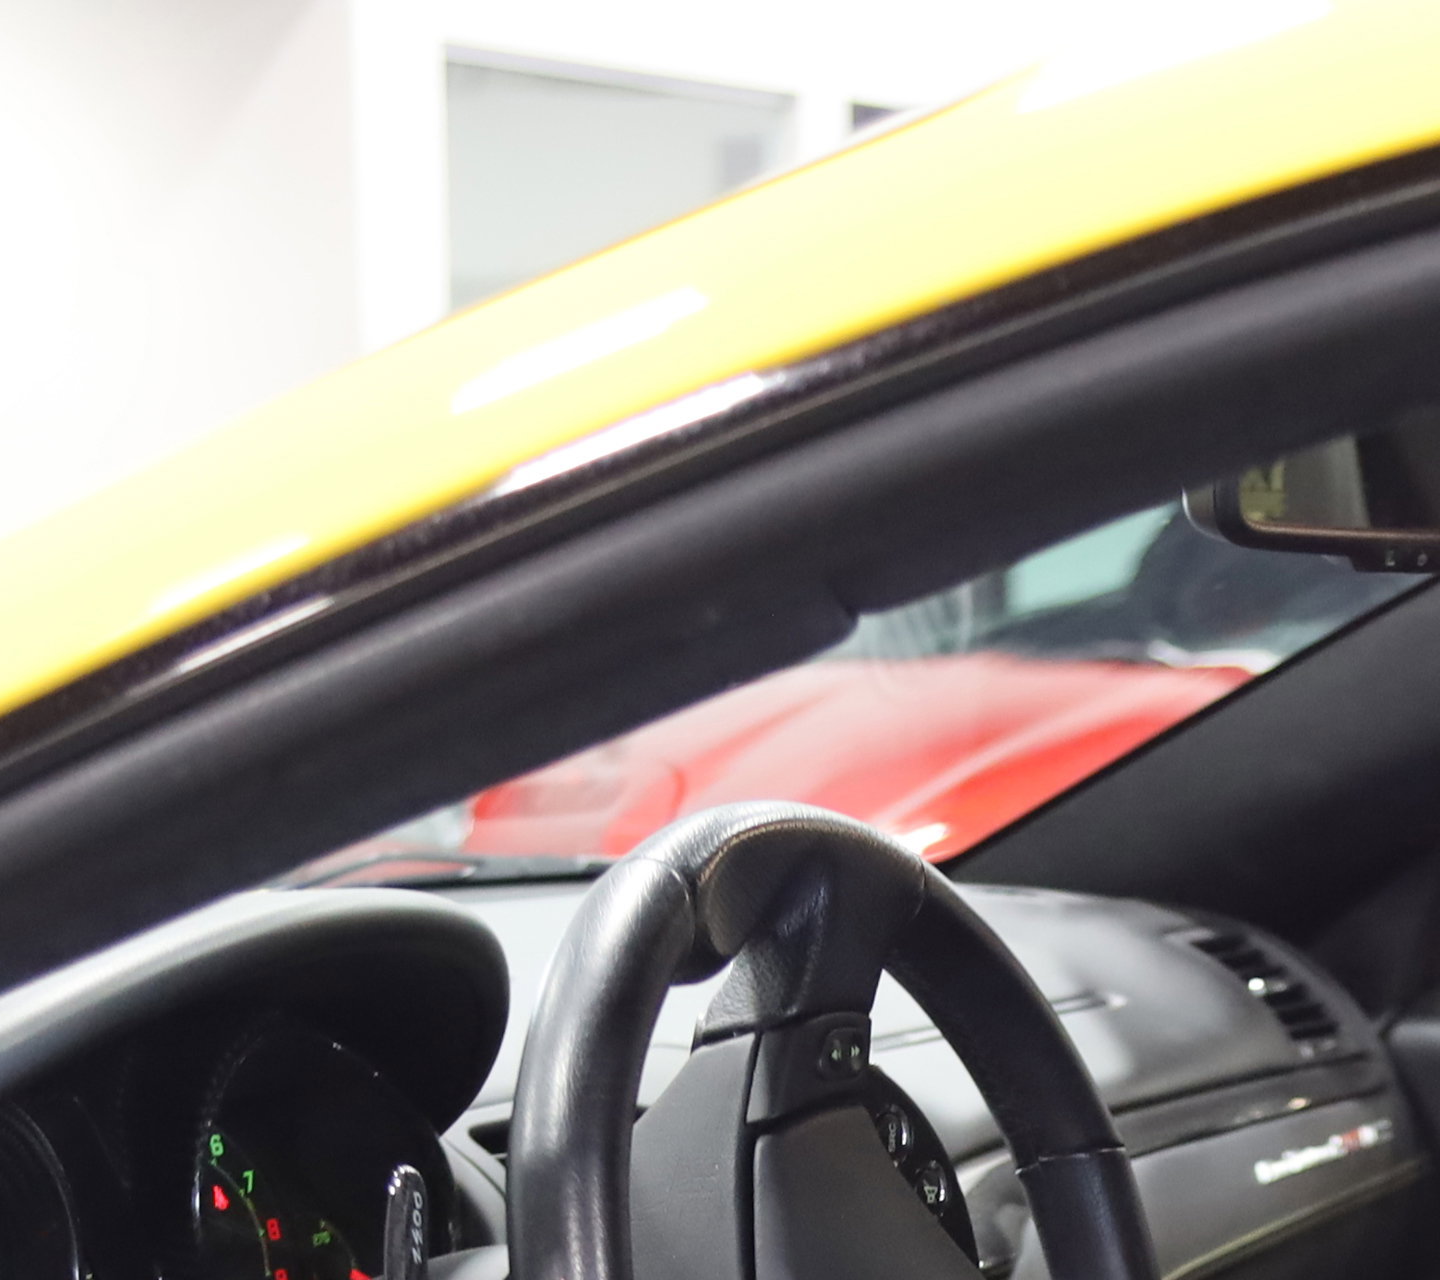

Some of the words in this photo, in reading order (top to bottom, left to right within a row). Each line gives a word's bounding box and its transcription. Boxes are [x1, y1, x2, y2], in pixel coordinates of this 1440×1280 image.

[210, 1133, 224, 1157] 6
[242, 1169, 255, 1193] 7
[266, 1217, 281, 1241] 8
[411, 1191, 423, 1265] DOWN
